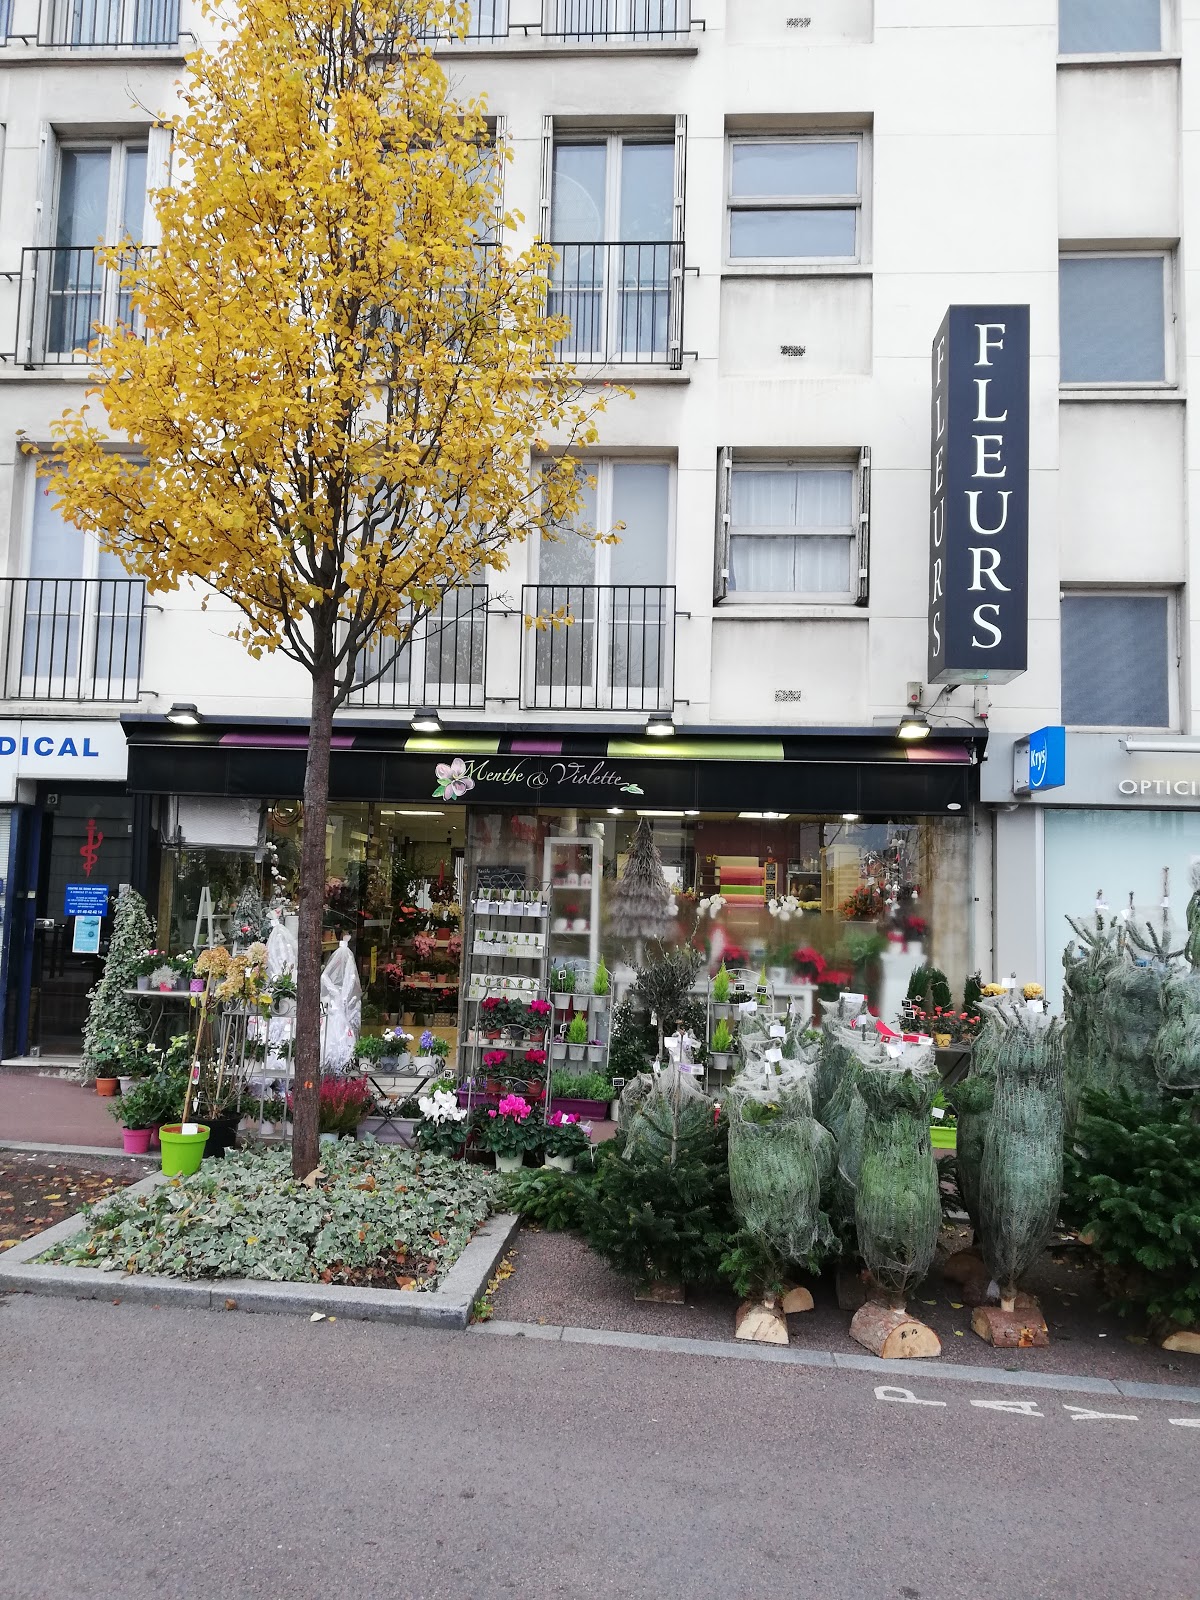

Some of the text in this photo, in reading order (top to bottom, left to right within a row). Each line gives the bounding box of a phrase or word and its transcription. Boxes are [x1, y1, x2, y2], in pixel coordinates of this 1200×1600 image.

[932, 336, 945, 658] FLEURS
[964, 323, 1013, 649] FLEURS
[0, 736, 99, 757] DICAL
[1030, 747, 1046, 771] Krys
[453, 758, 630, 789] Menthe & Violette
